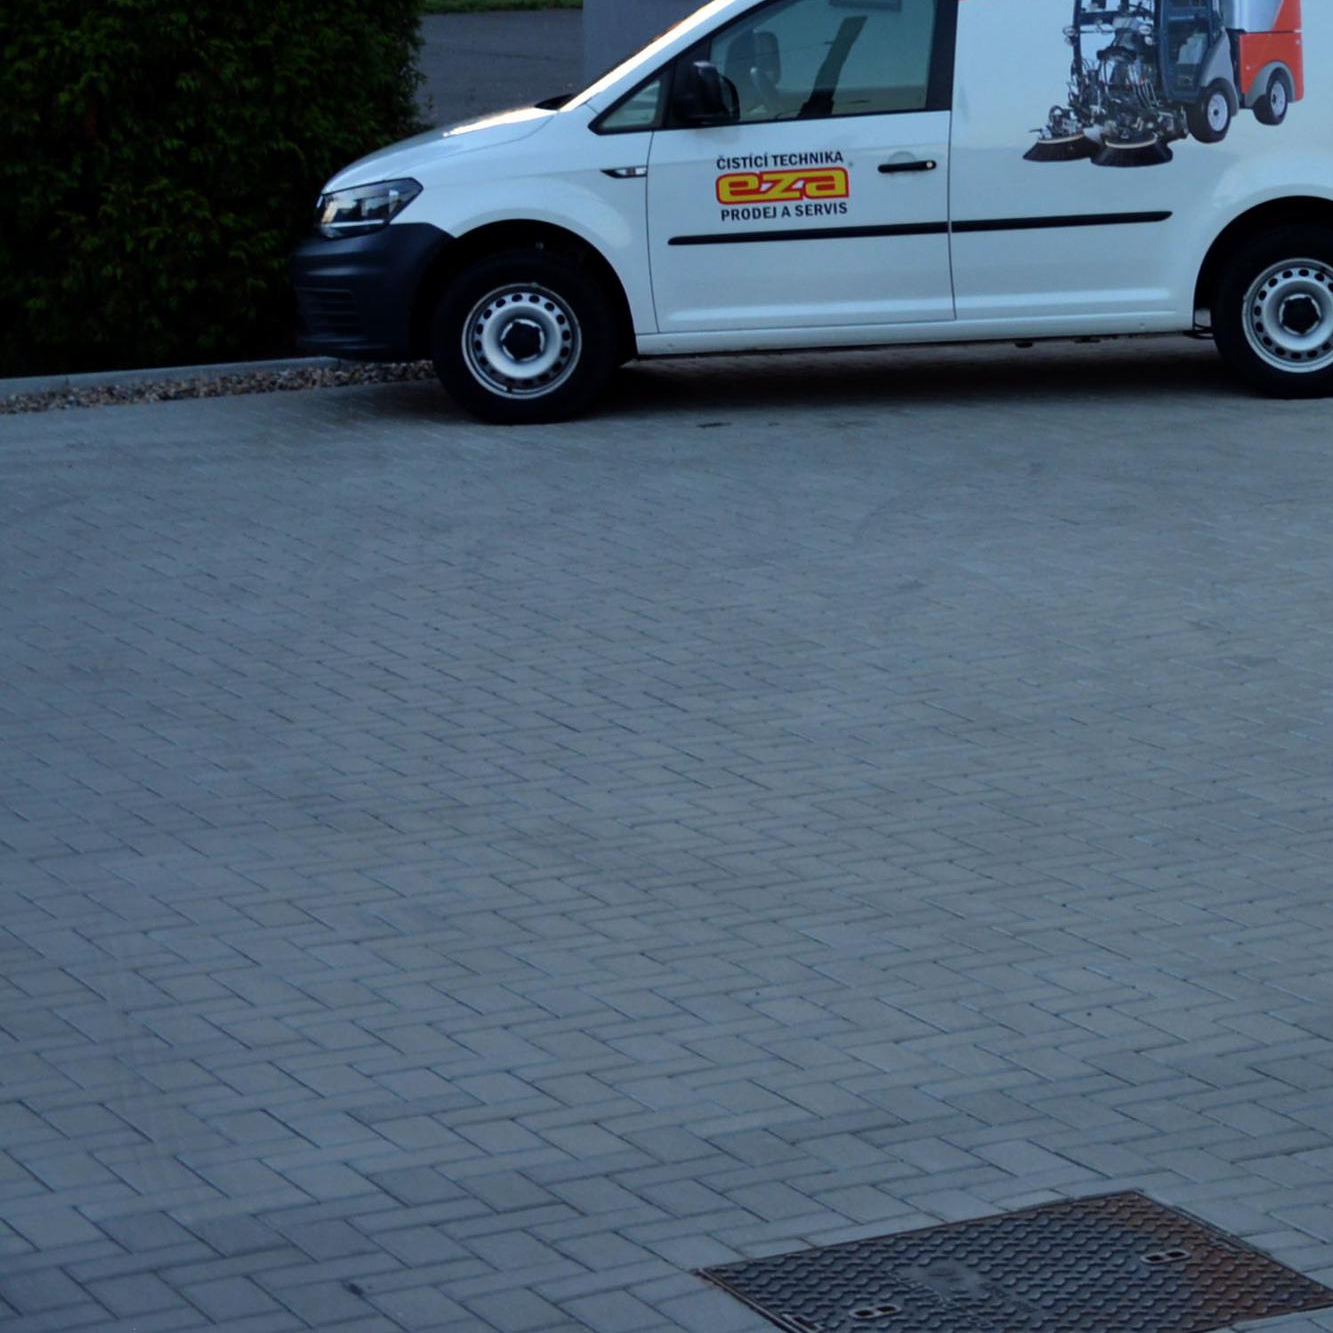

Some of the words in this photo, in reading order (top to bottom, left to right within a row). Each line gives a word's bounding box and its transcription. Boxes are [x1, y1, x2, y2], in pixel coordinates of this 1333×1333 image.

[772, 151, 844, 167] TECHNIKA
[715, 167, 849, 205] eza
[721, 206, 776, 221] PRODEJ
[781, 205, 791, 218] A
[795, 202, 848, 217] SERVIS
